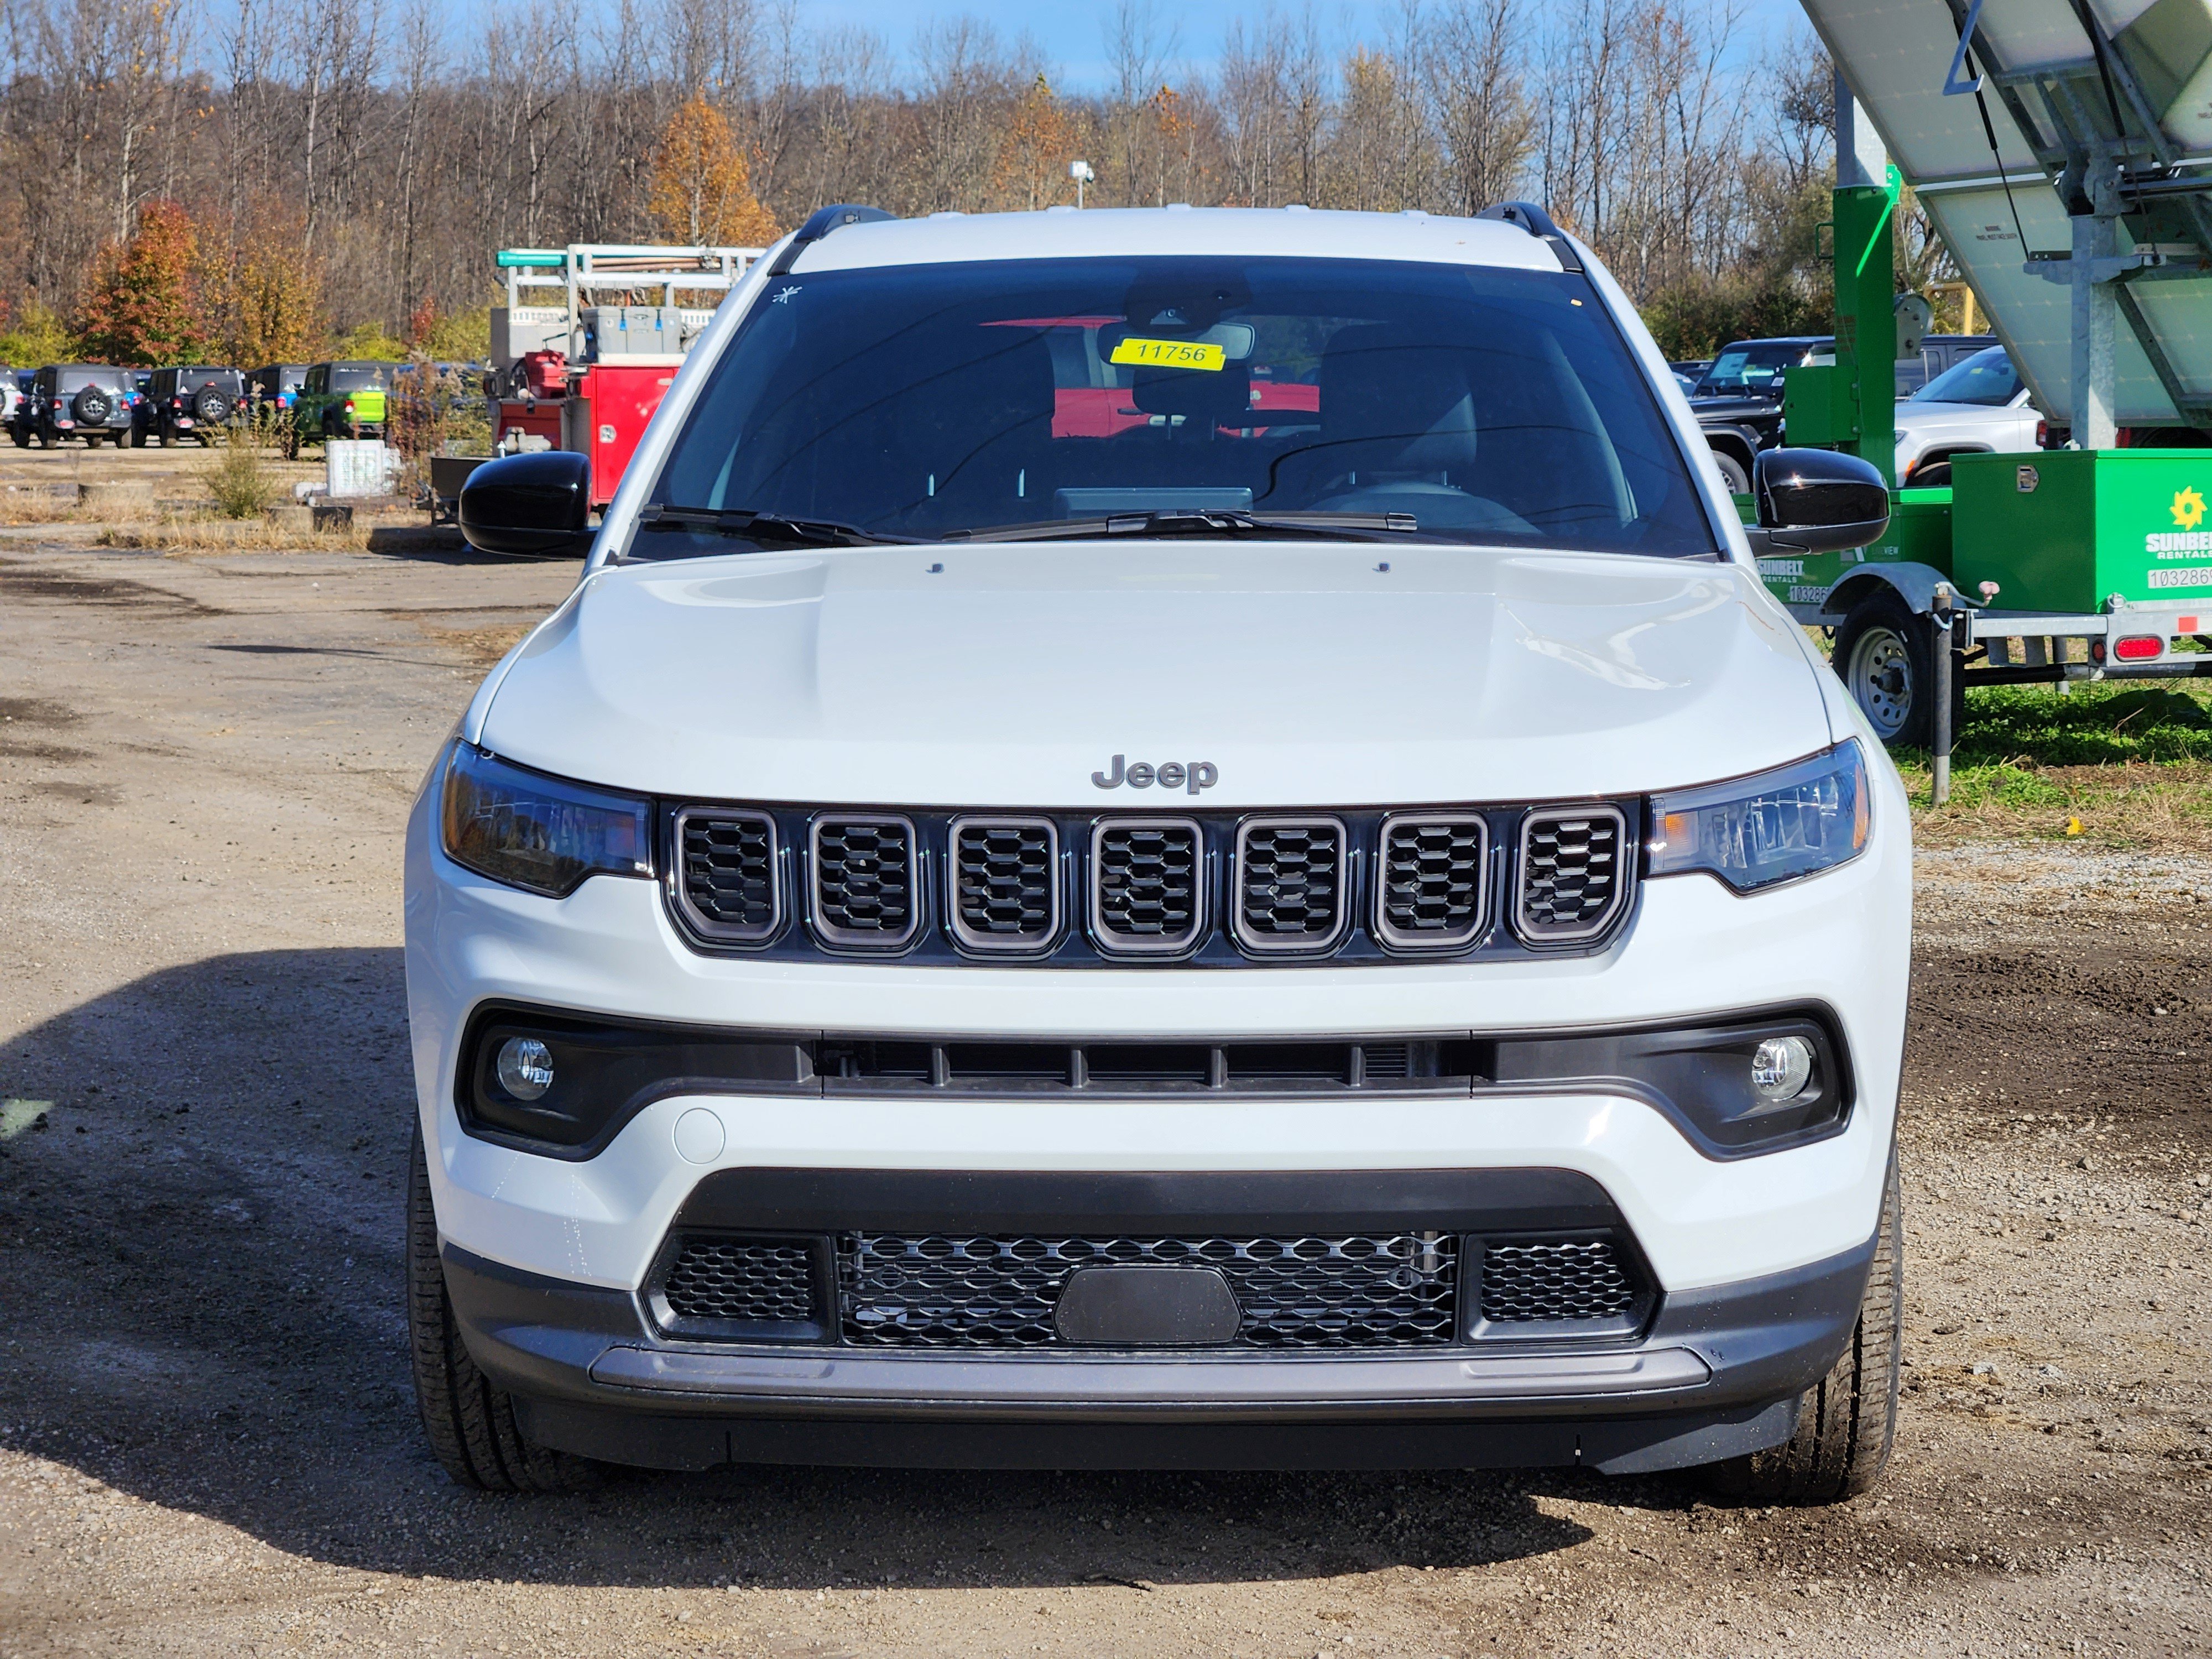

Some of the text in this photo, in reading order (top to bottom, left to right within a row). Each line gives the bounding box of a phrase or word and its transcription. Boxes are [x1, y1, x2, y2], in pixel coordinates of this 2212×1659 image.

[1138, 344, 1207, 361] 11756
[1756, 560, 1804, 576] SUNBELT
[2151, 568, 2212, 587] 103286
[1791, 587, 1830, 601] 103286
[1091, 754, 1218, 795] Jeep
